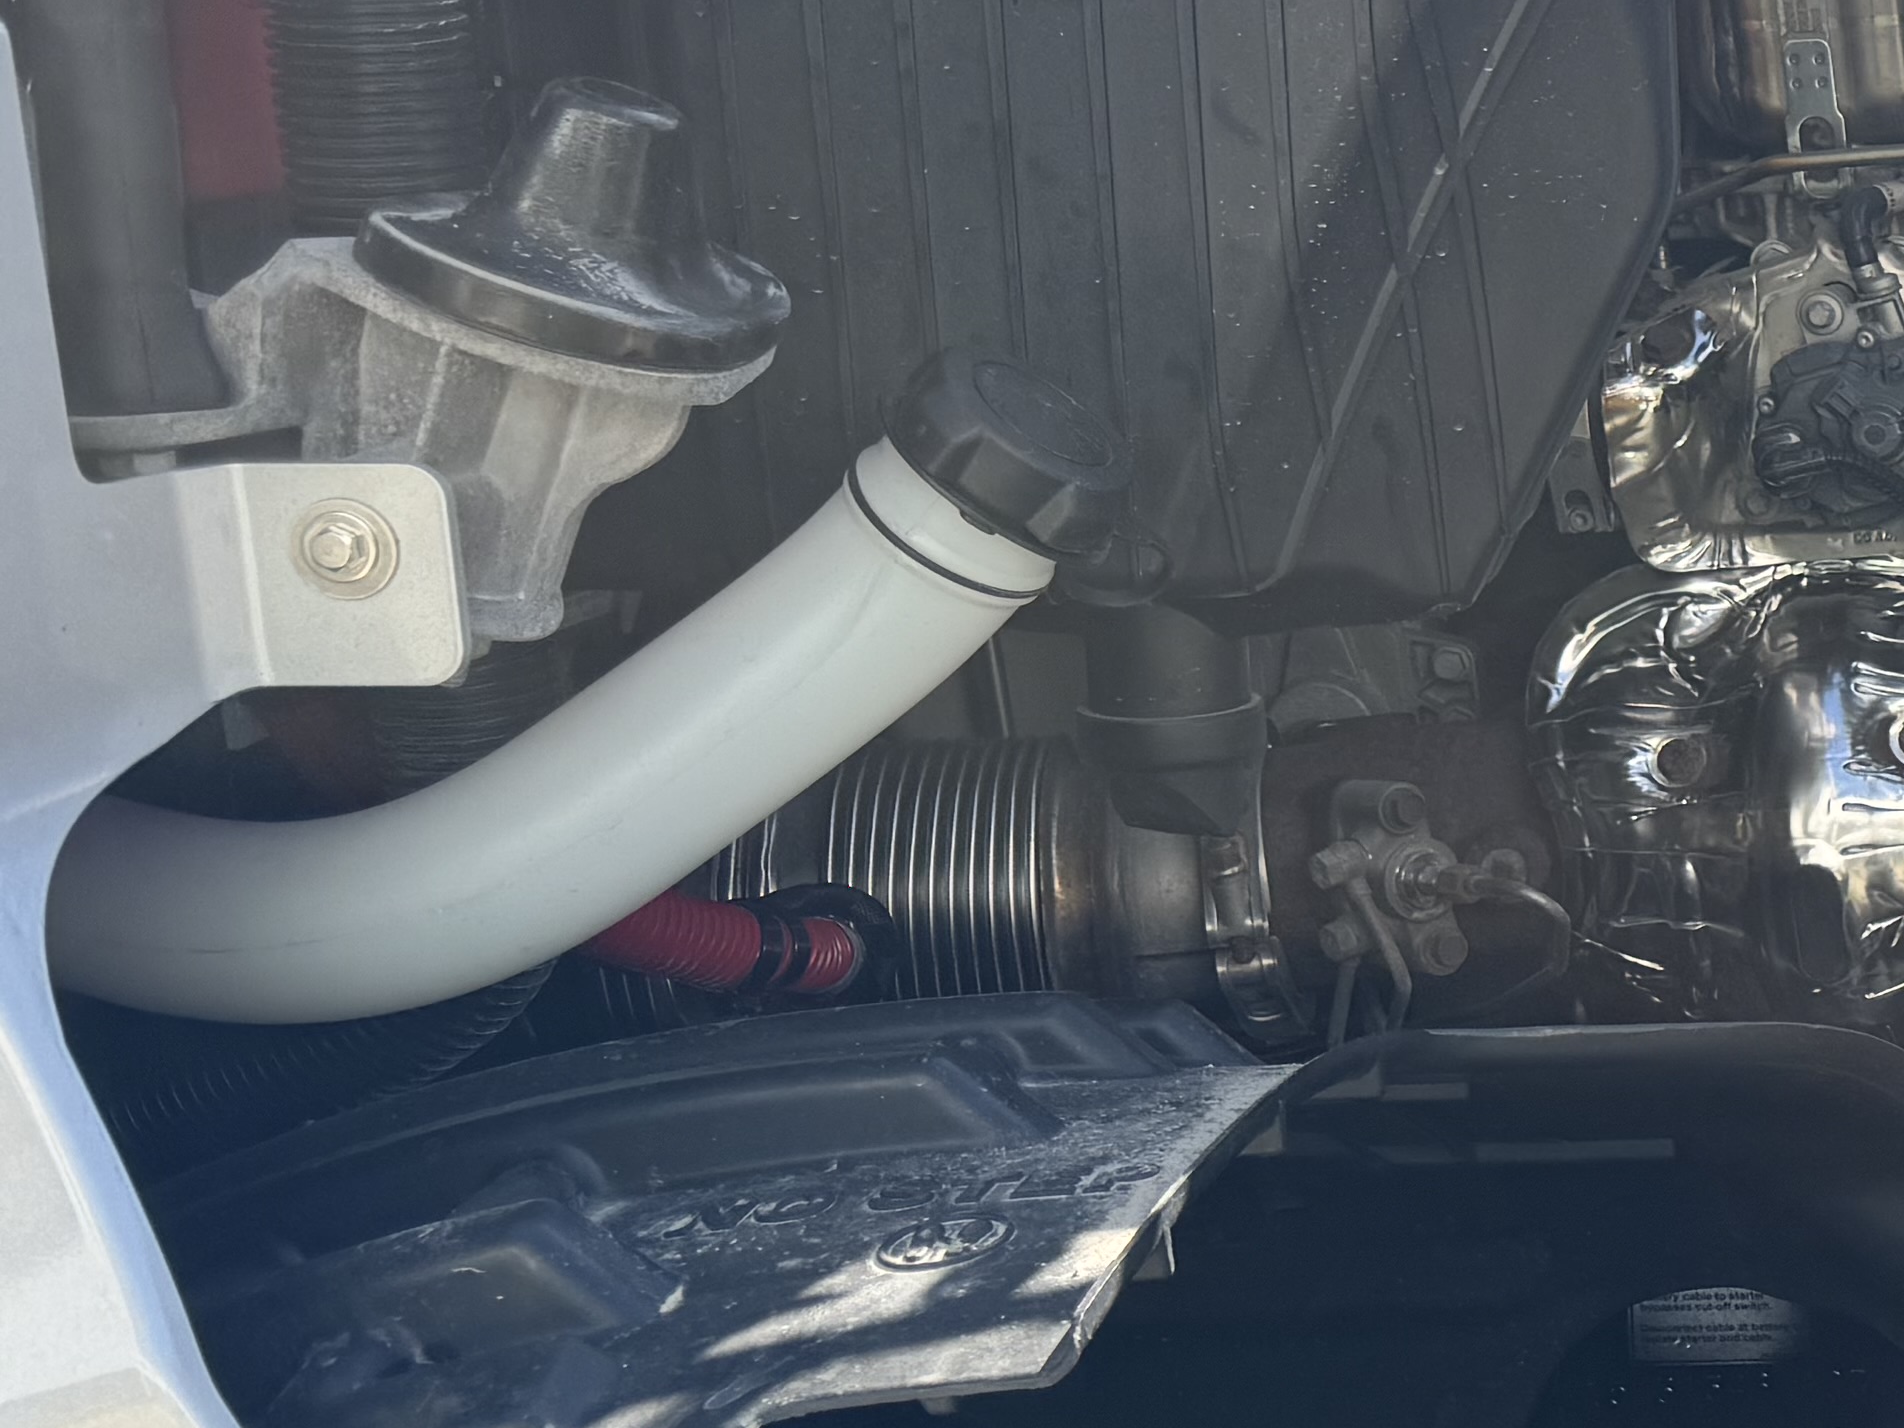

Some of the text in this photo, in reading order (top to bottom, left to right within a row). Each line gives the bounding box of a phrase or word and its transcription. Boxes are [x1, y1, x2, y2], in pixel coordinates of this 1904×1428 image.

[660, 1160, 1162, 1242] NO STEP
[1682, 1291, 1713, 1301] cable
[1714, 1291, 1727, 1302] to
